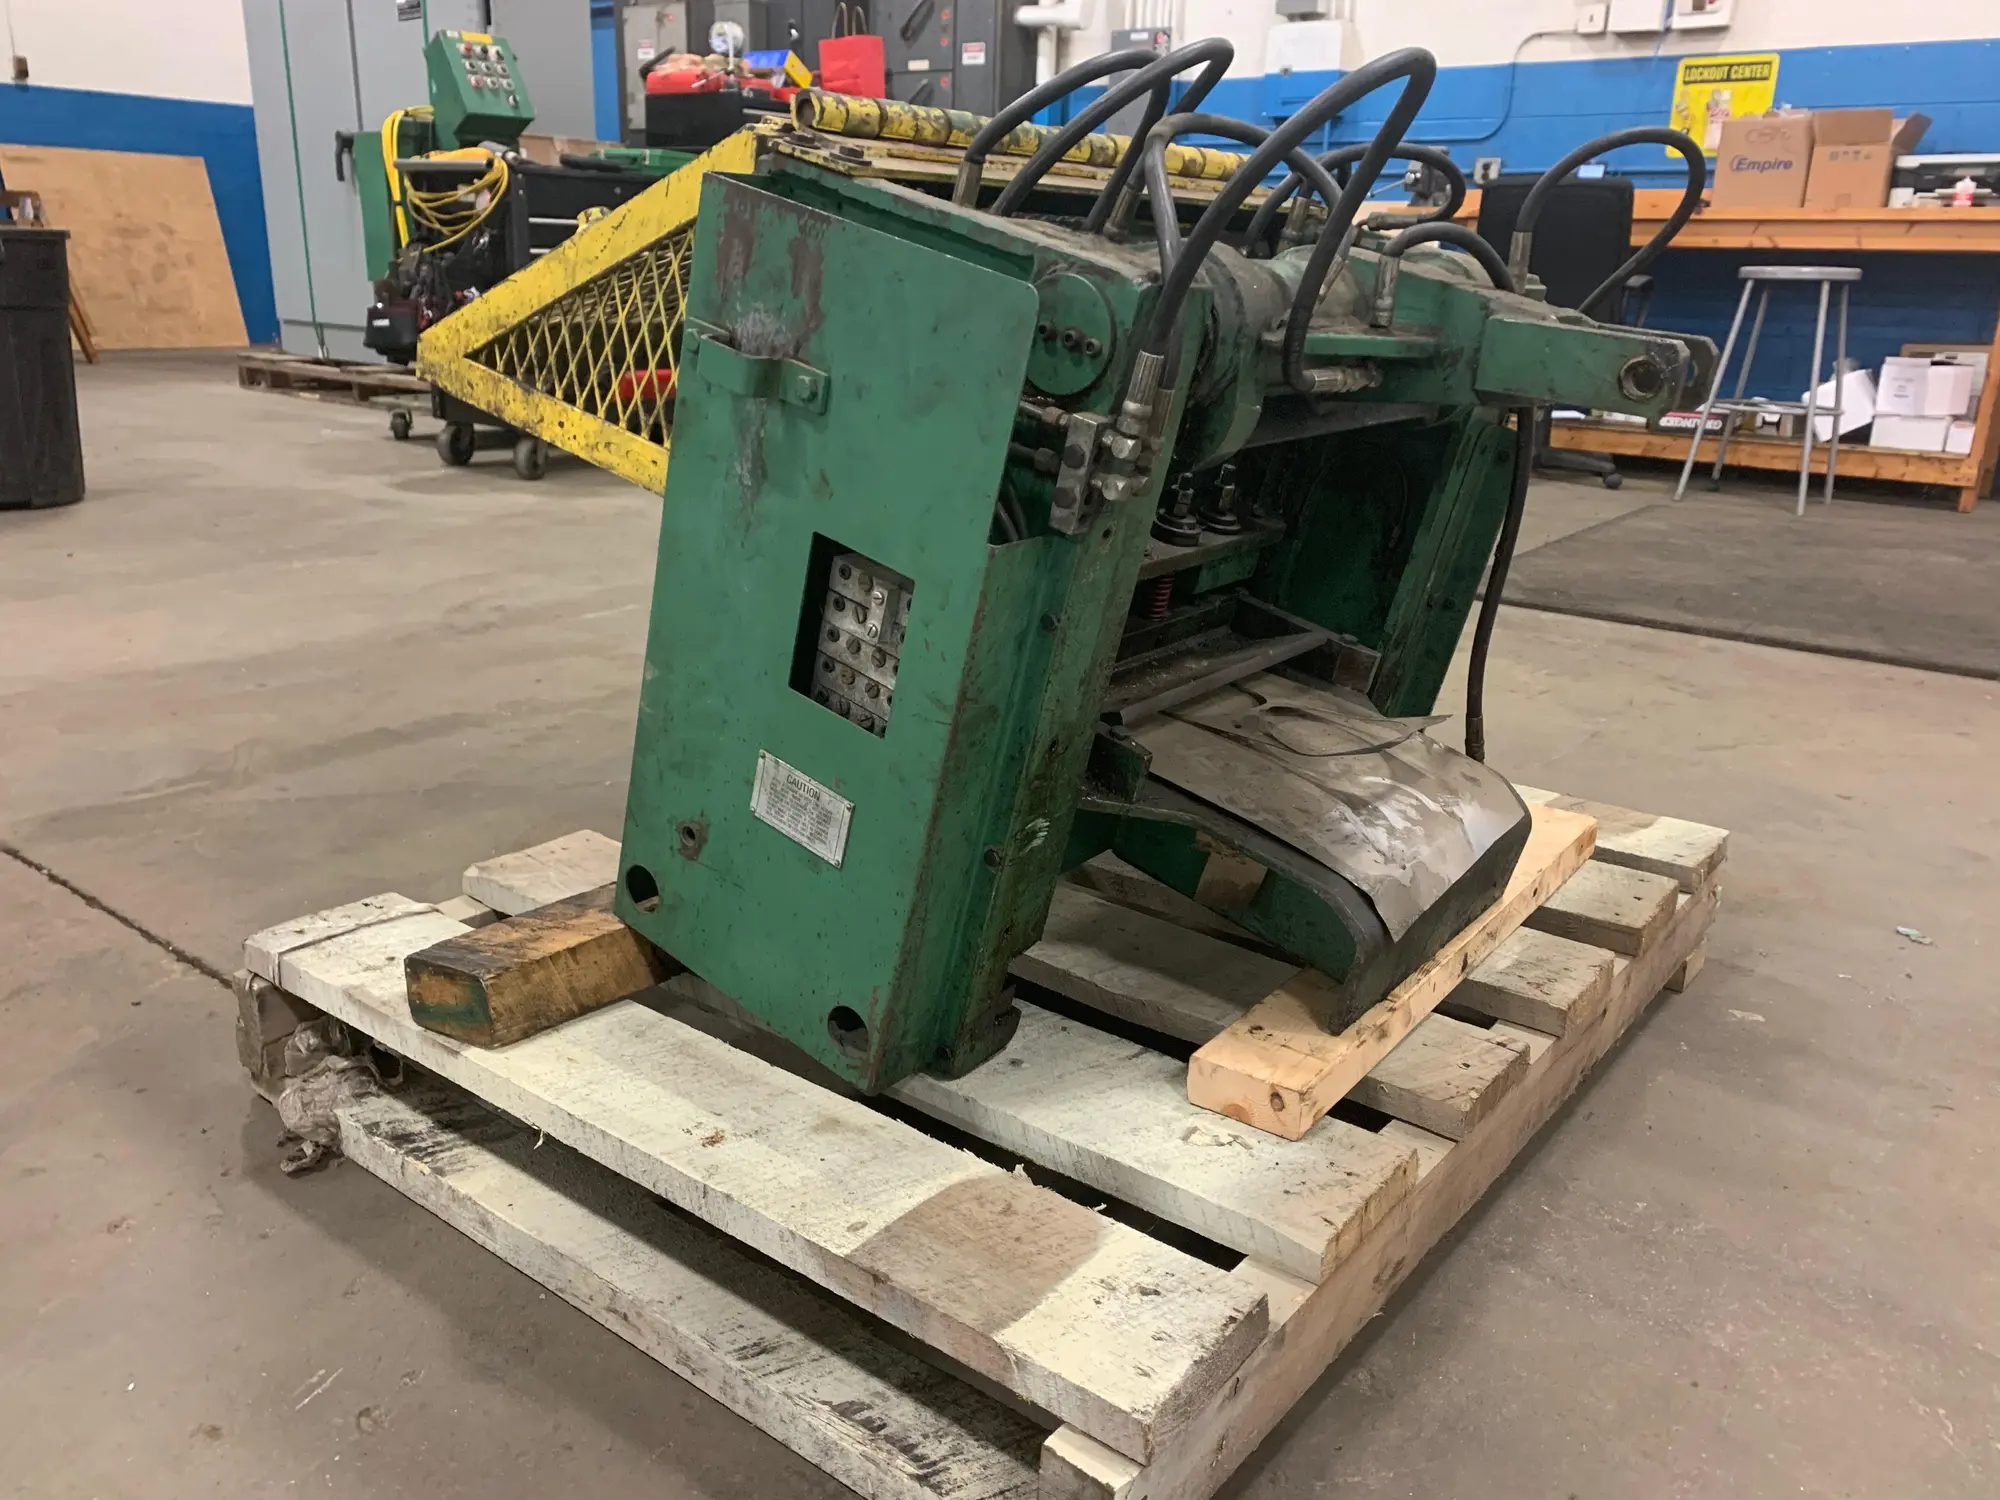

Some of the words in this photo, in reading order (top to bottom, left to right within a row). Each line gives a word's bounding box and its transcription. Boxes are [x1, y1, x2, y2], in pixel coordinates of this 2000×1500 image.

[1685, 66, 1729, 82] LOCKOUT
[1730, 64, 1770, 80] CENTER
[1732, 156, 1793, 173] Empire
[786, 774, 821, 801] CAUTION
